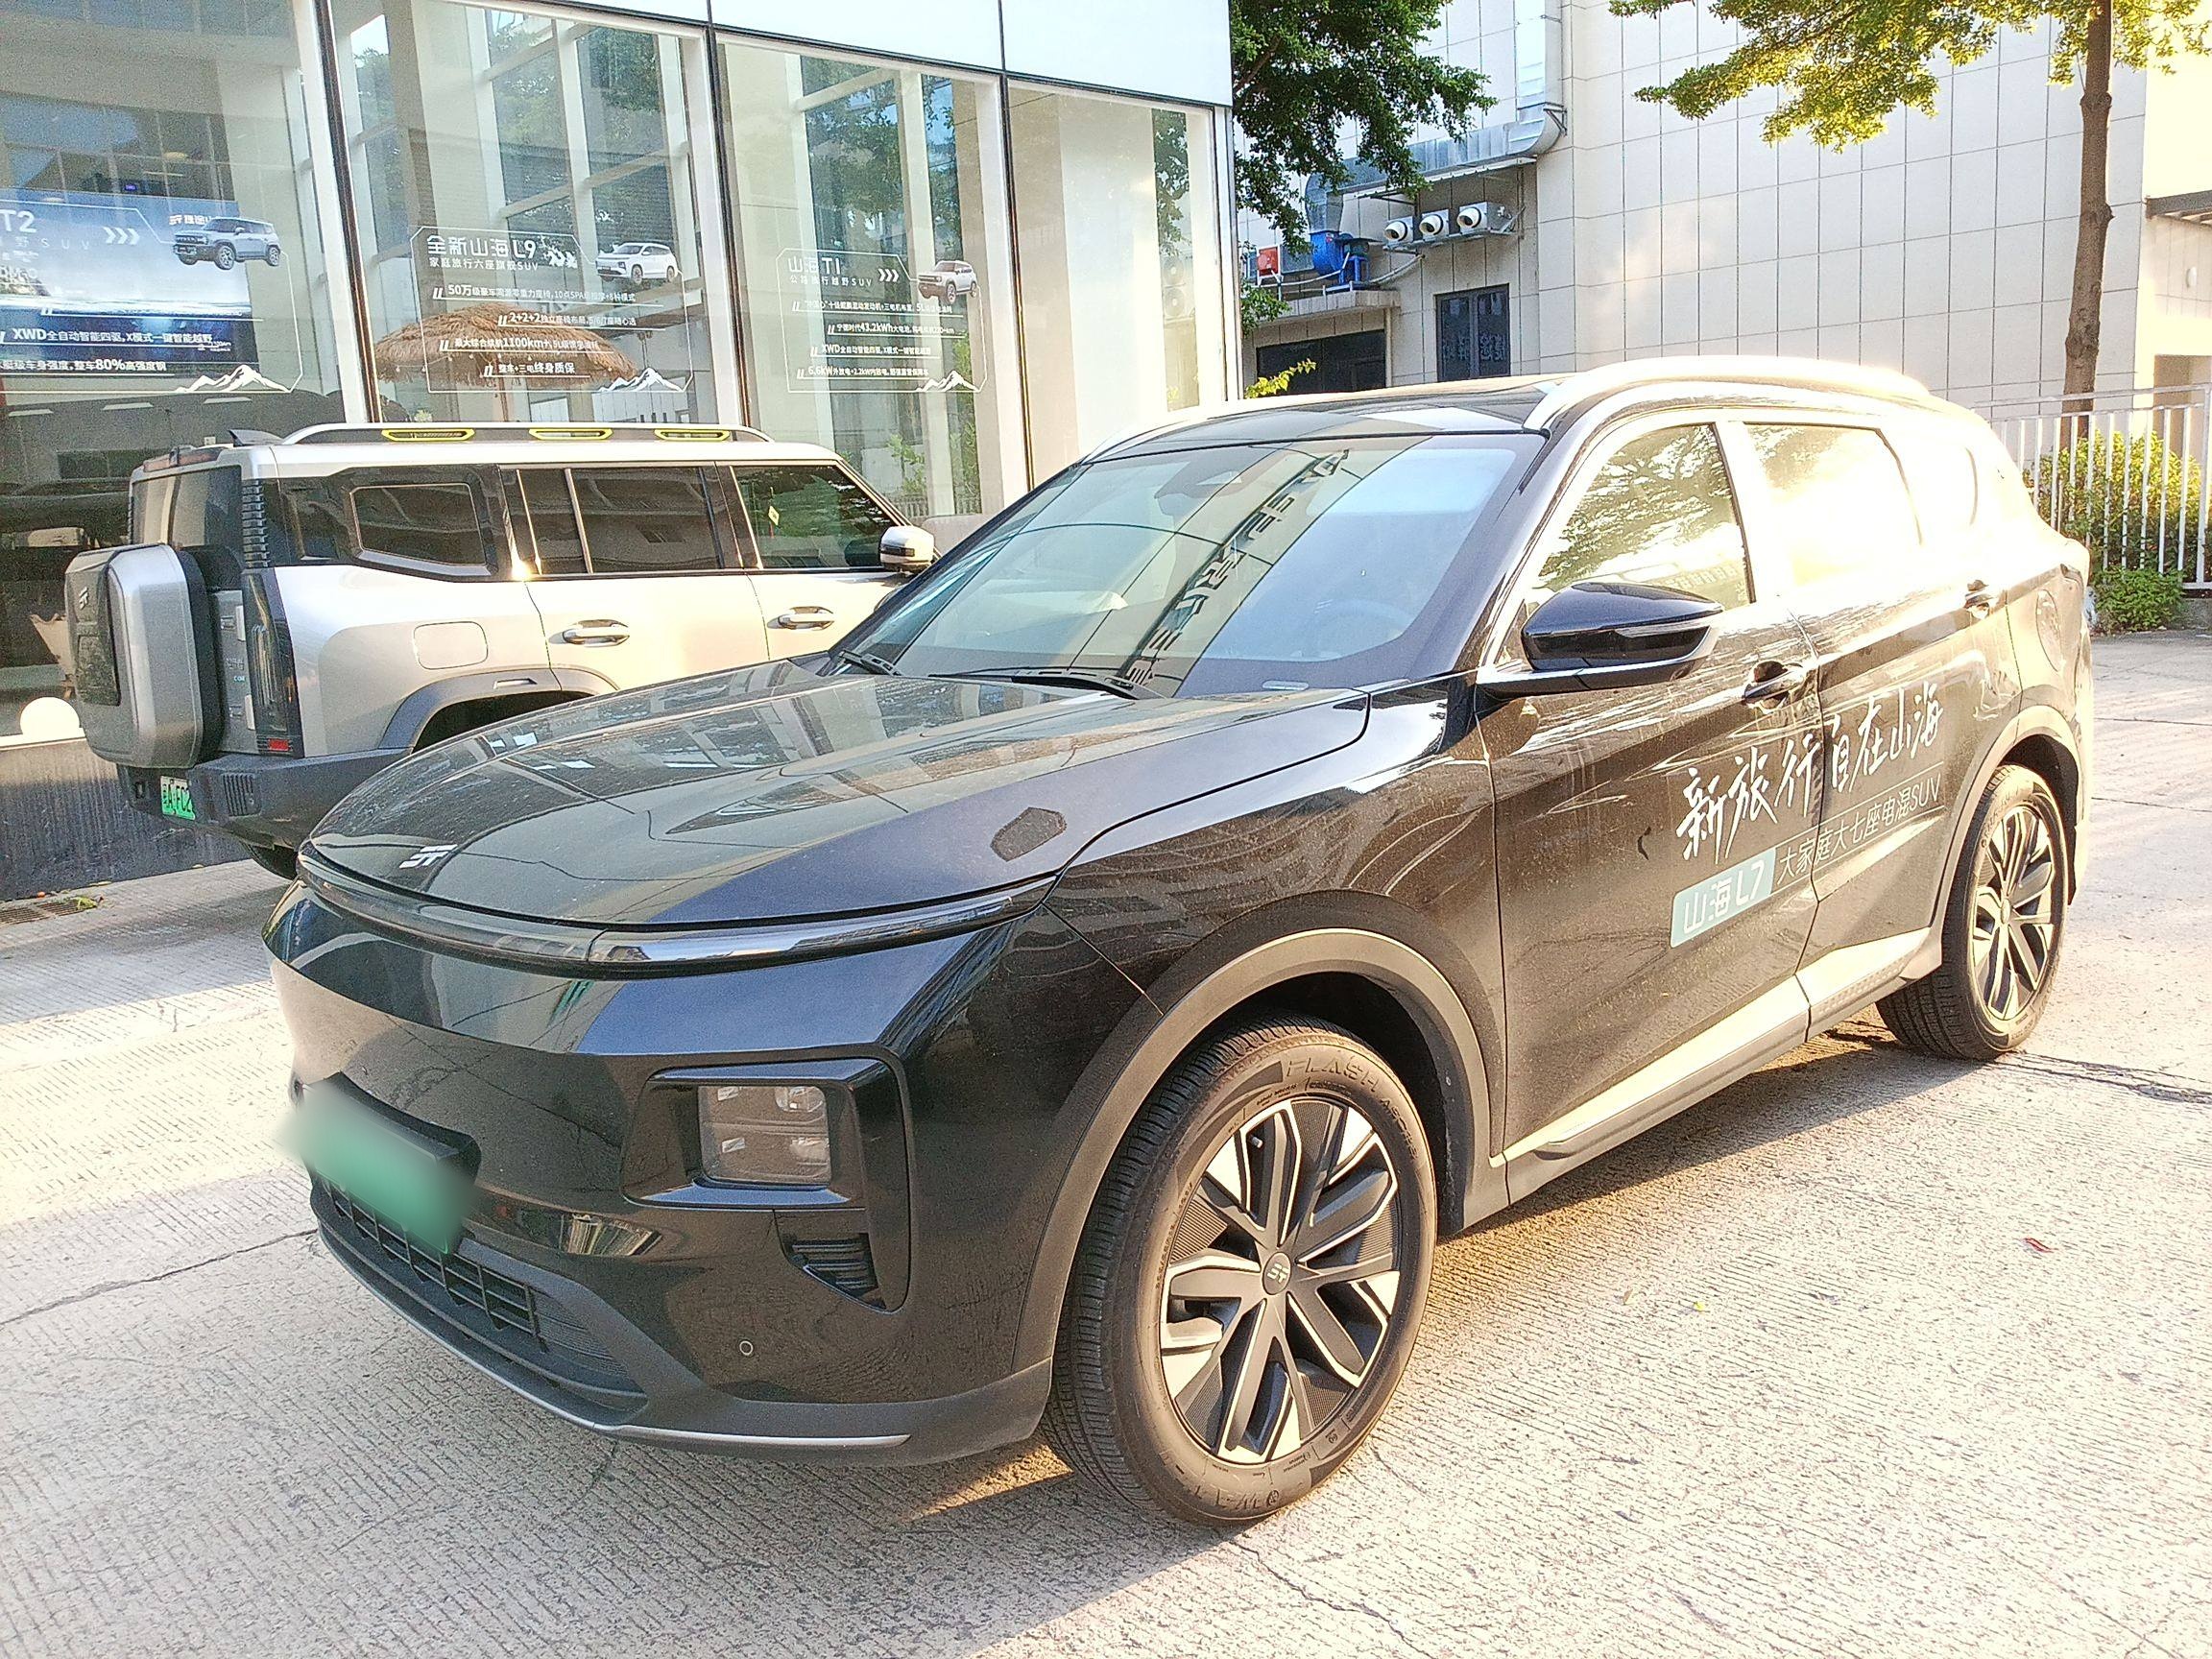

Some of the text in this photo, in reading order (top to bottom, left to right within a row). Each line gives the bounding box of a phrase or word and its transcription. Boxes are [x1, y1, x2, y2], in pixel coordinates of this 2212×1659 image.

[428, 256, 539, 271] 家庭旅行六座旗舰SUV
[0, 358, 166, 372] 艇级车身强度,整车80%高强度钢
[1776, 773, 1942, 885] 大家庭大七座电混SUV
[1683, 859, 1766, 936] 山海L7
